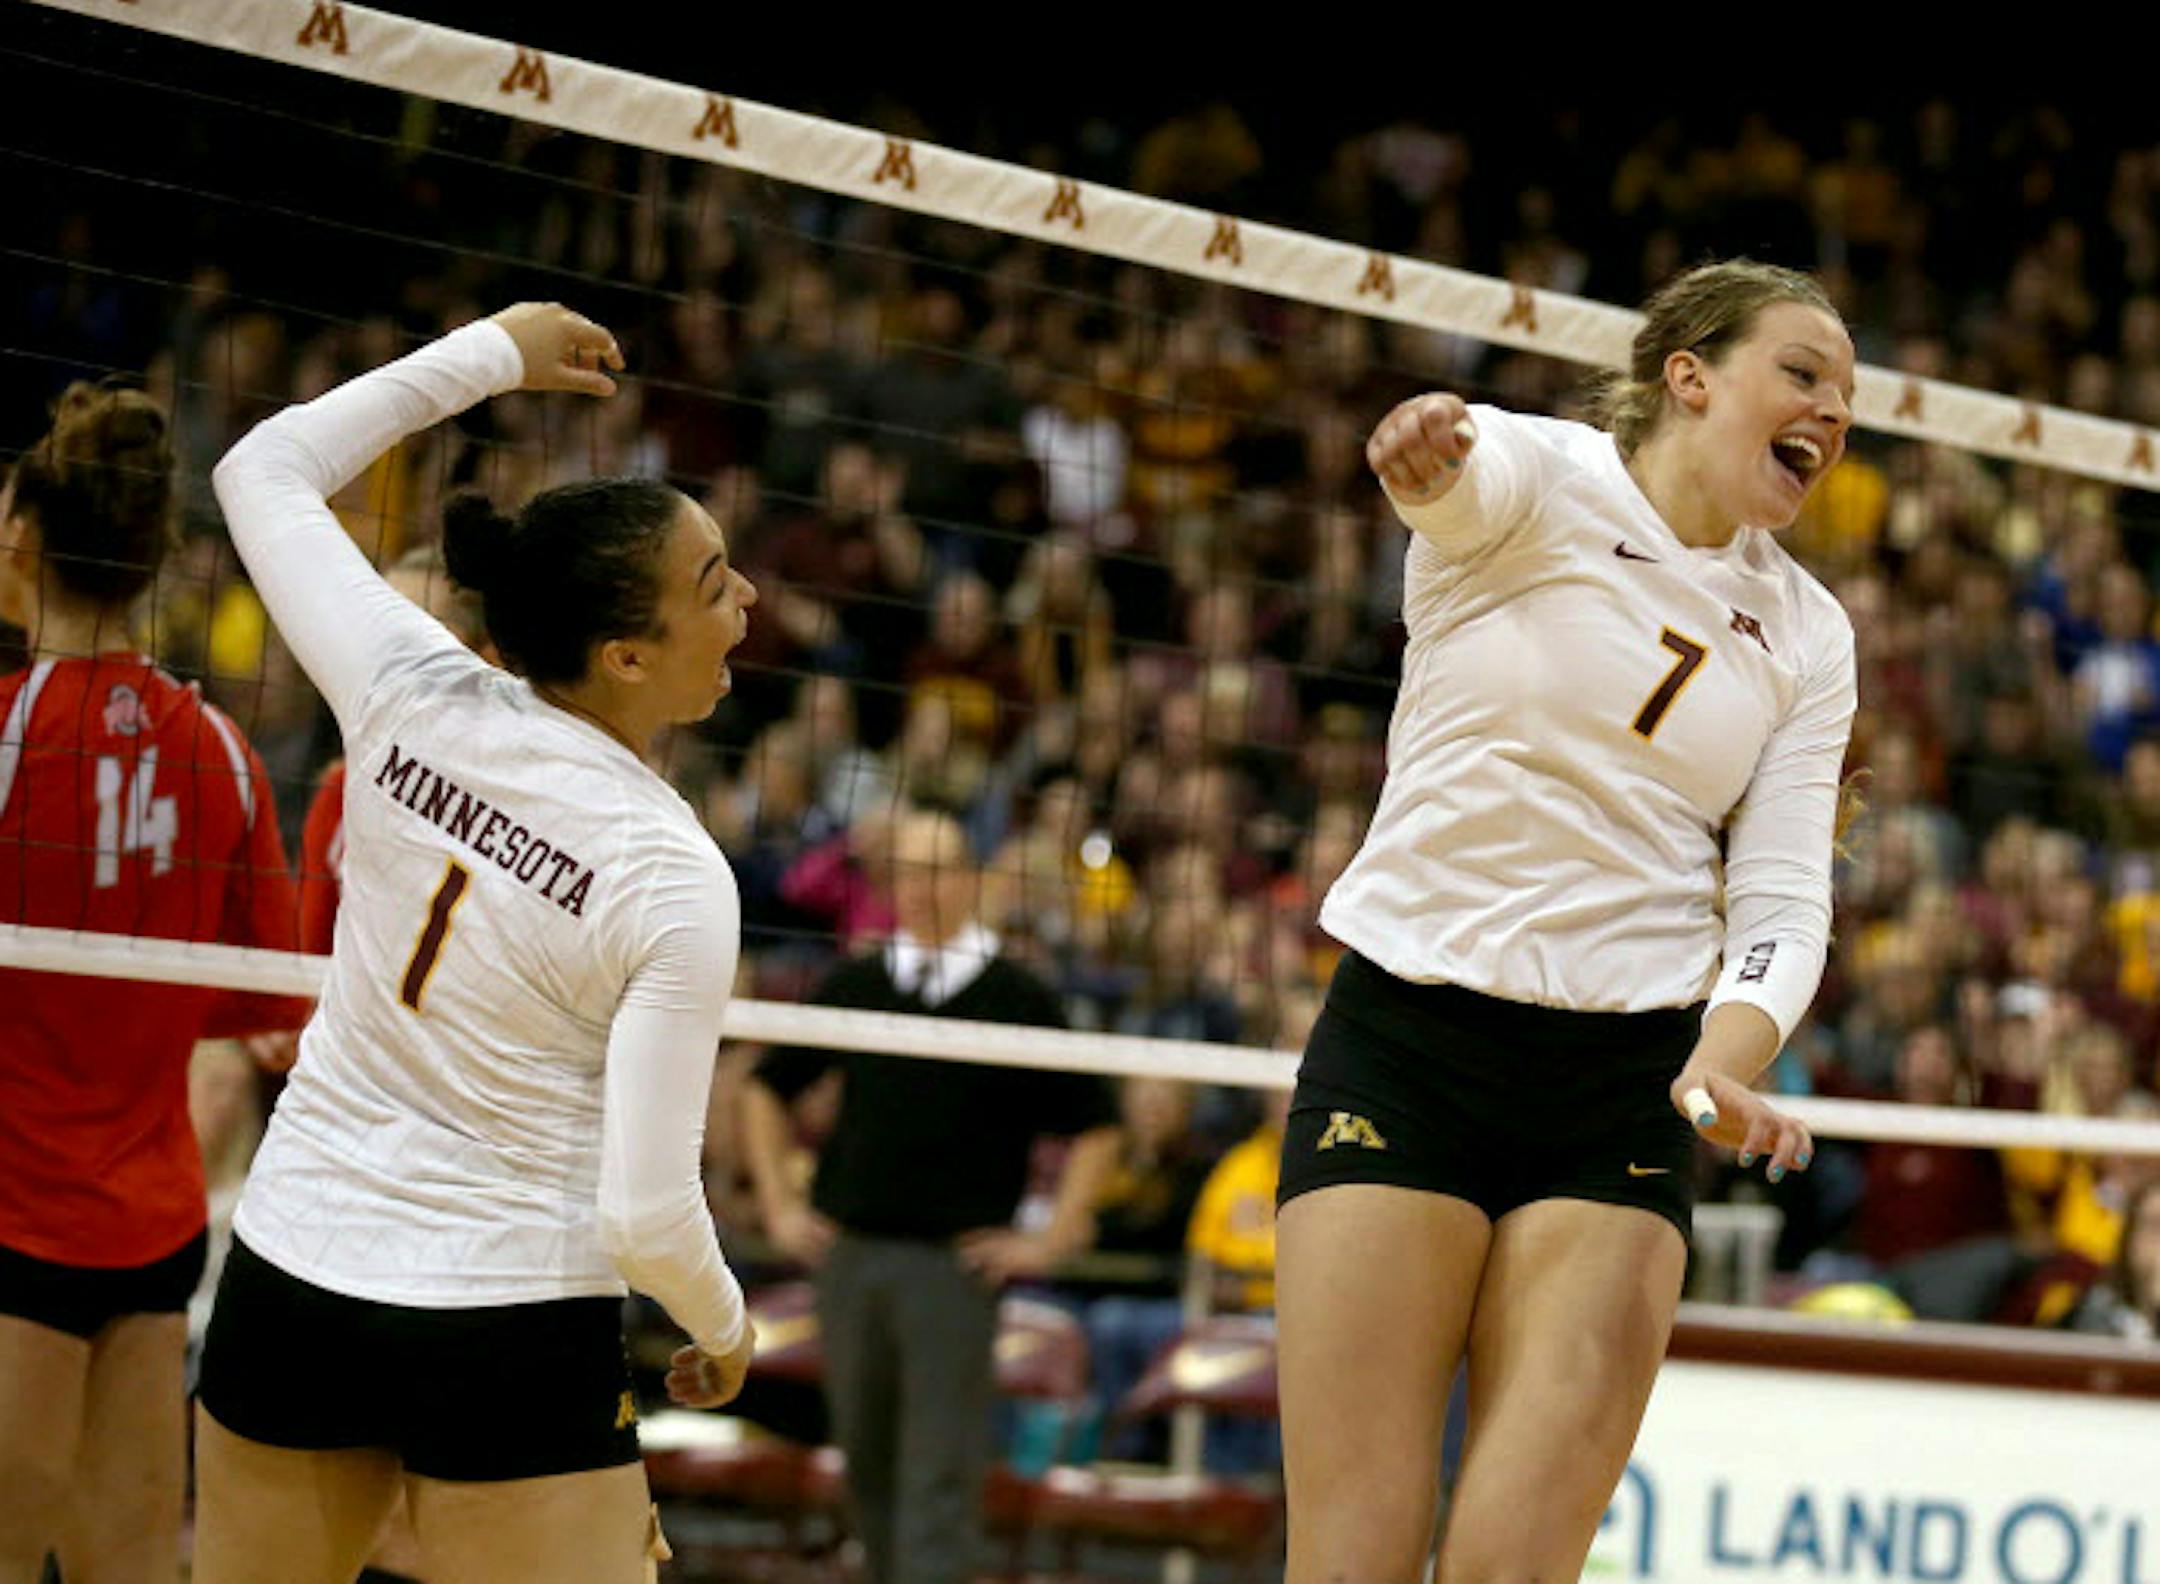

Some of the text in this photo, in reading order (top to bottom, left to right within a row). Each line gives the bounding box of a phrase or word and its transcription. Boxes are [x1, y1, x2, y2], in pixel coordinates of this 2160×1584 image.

[297, 1, 347, 55] M
[500, 44, 551, 101] M
[693, 96, 739, 149] M
[873, 137, 916, 190] M
[1043, 177, 1085, 229] M
[1204, 216, 1242, 266] M
[1357, 251, 1396, 302] M
[1628, 624, 1709, 743] 7
[95, 745, 179, 888] 14
[375, 743, 595, 918] MINNESOTA
[397, 854, 472, 1013] 1
[1316, 1111, 1387, 1151] M
[1708, 1482, 1967, 1582] LAND
